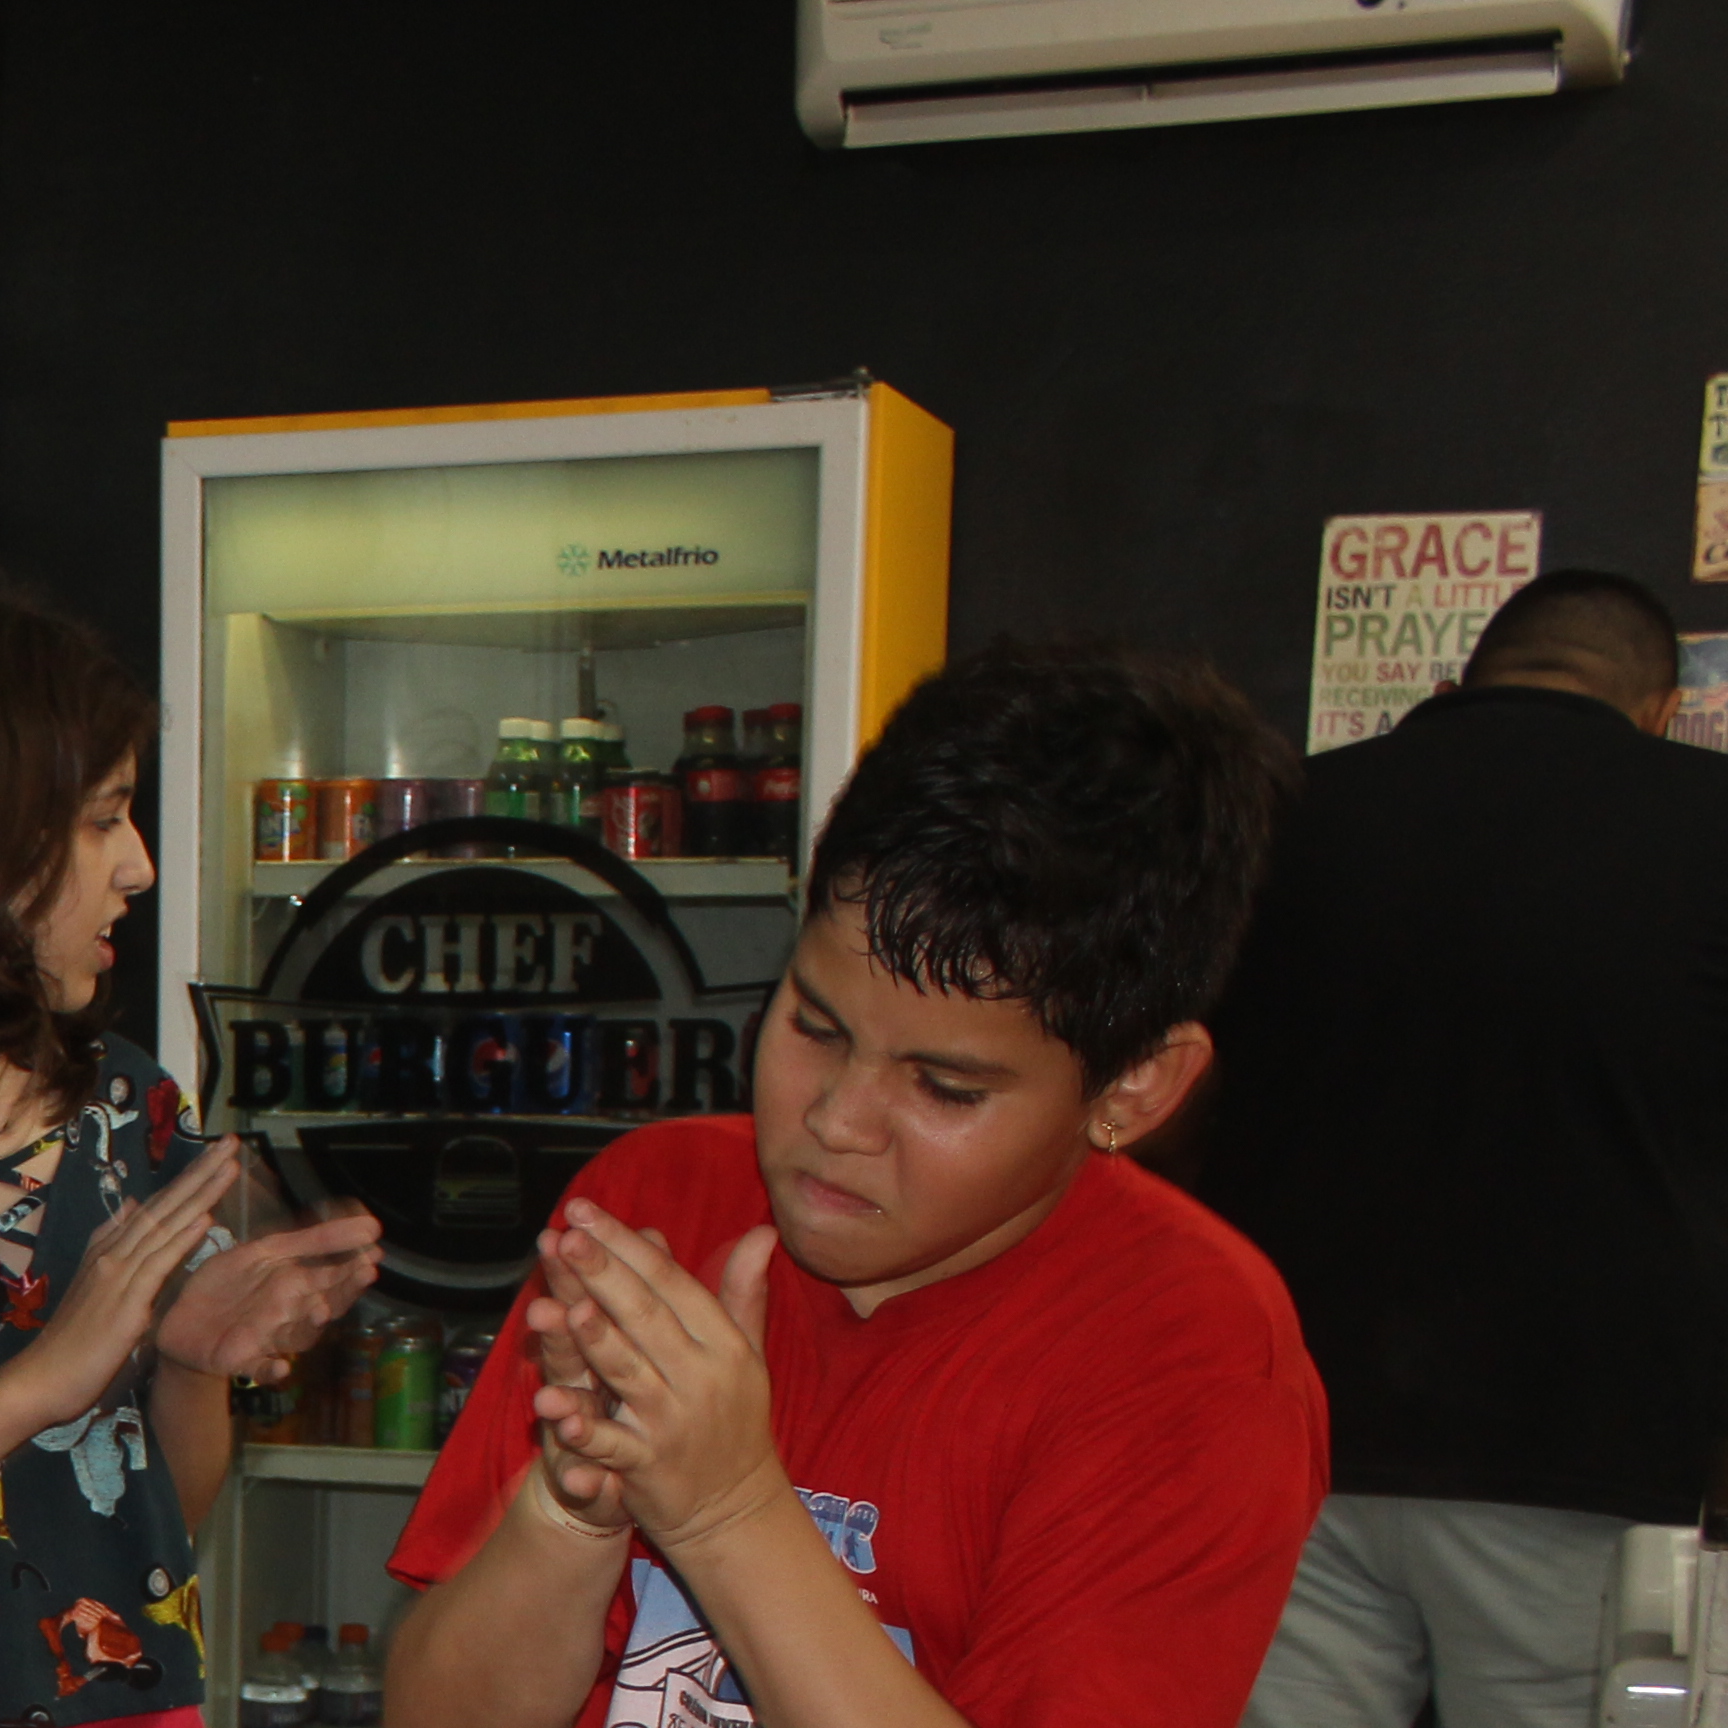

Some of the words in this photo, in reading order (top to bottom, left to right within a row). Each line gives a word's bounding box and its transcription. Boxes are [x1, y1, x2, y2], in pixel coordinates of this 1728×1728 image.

[597, 544, 720, 570] Metalfrio
[1329, 521, 1532, 580] GRACE
[1326, 584, 1395, 610] ISN'T
[1322, 663, 1370, 682] YOU
[1376, 662, 1422, 682] SAY
[1315, 710, 1365, 737] IT'S
[359, 913, 602, 995] CHEF
[227, 1014, 744, 1112] BURGUER
